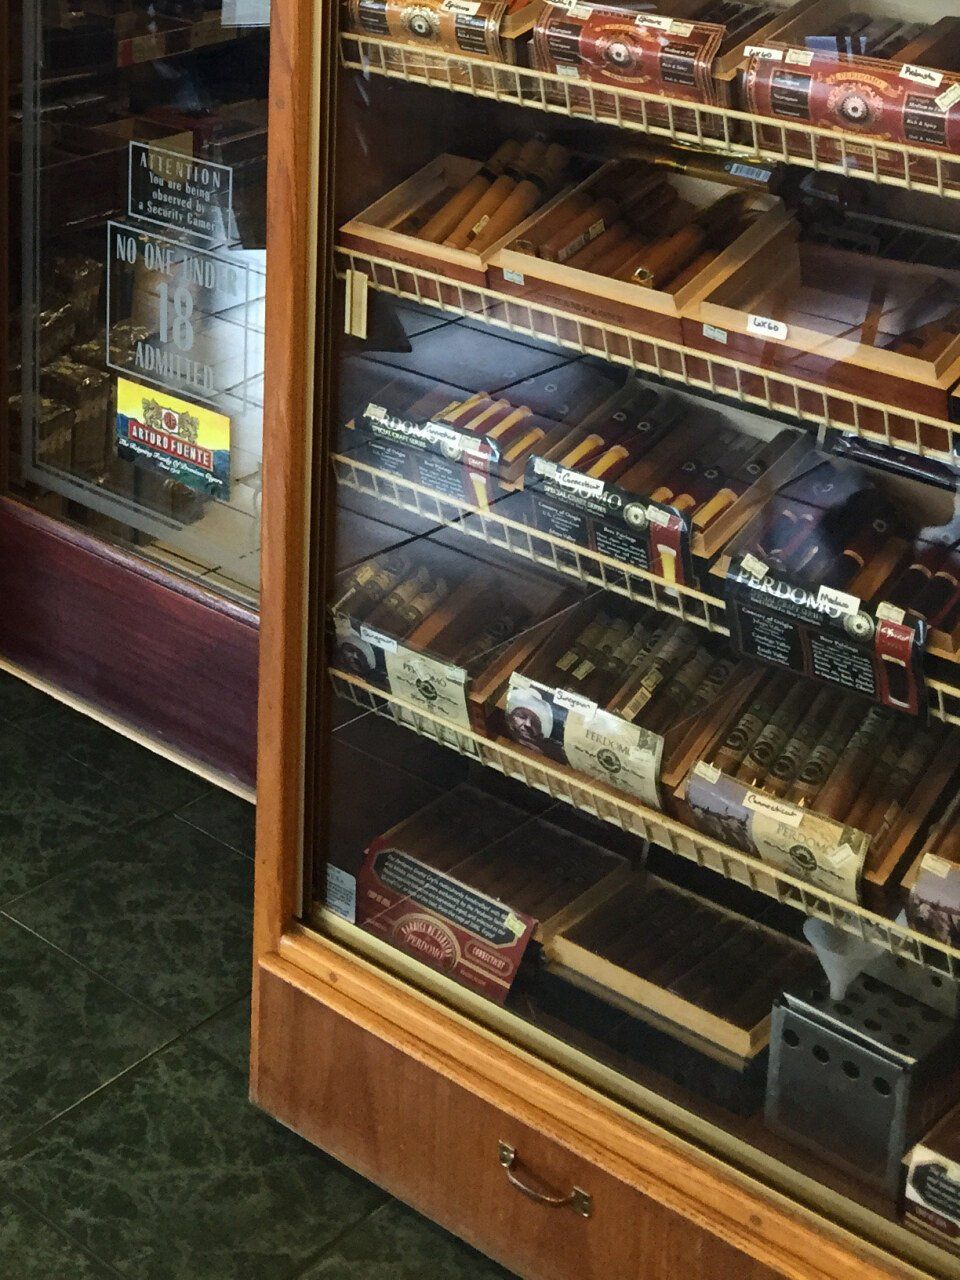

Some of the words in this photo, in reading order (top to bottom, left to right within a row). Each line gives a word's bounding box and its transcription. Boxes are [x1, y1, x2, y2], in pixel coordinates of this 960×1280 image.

[140, 151, 221, 188] ATTENTION
[148, 170, 164, 187] You
[167, 179, 182, 191] are
[185, 181, 211, 202] being
[138, 201, 144, 211] a
[147, 200, 183, 222] Security
[187, 212, 216, 231] Camer
[152, 188, 192, 210] observed
[195, 200, 205, 214] by
[116, 233, 137, 265] NO
[144, 242, 175, 277] ONE
[182, 255, 238, 297] UNDR
[155, 281, 194, 352] 18
[134, 341, 215, 391] ADMITTED
[131, 424, 169, 450] ARTURO
[170, 439, 210, 467] FUENTE
[407, 932, 444, 959] PERDOMO
